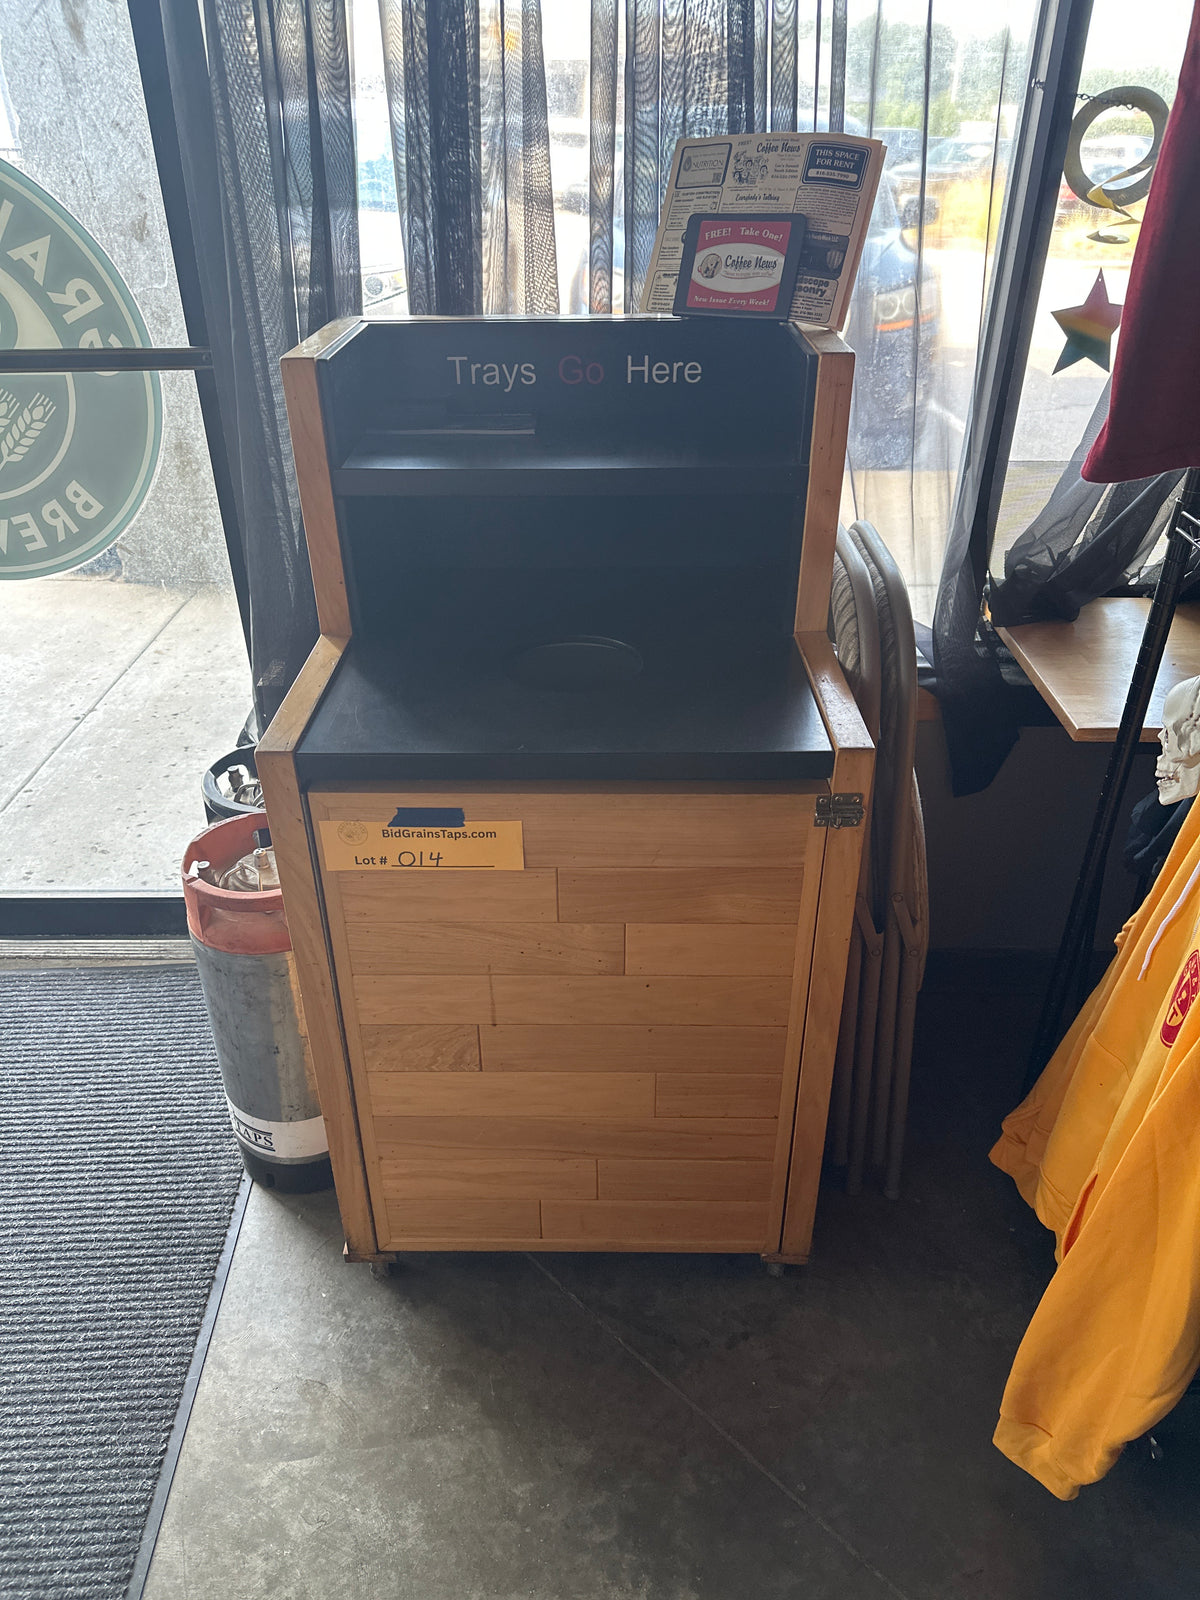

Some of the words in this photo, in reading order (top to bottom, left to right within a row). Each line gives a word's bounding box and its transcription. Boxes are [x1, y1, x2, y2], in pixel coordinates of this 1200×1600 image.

[757, 142, 779, 154] Coffee
[780, 142, 801, 153] News
[815, 149, 833, 157] THIS
[835, 150, 860, 161] SPACE
[692, 160, 725, 168] NUTRITION
[815, 158, 832, 167] FOR
[833, 159, 856, 169] RENT
[705, 227, 732, 241] FREE!
[740, 226, 760, 237] Take
[762, 228, 784, 242] One!
[725, 254, 752, 271] Coffee
[754, 255, 778, 270] News
[694, 295, 707, 303] New
[709, 296, 728, 304] Issue
[728, 297, 747, 306] Every
[749, 297, 770, 306] Week!
[446, 355, 537, 393] Trays
[558, 354, 605, 385] Go
[626, 355, 702, 384] Here
[381, 828, 498, 840] BidGrainsTaps.com
[354, 855, 376, 866] Lot
[378, 855, 388, 866] #
[398, 850, 444, 867] 014
